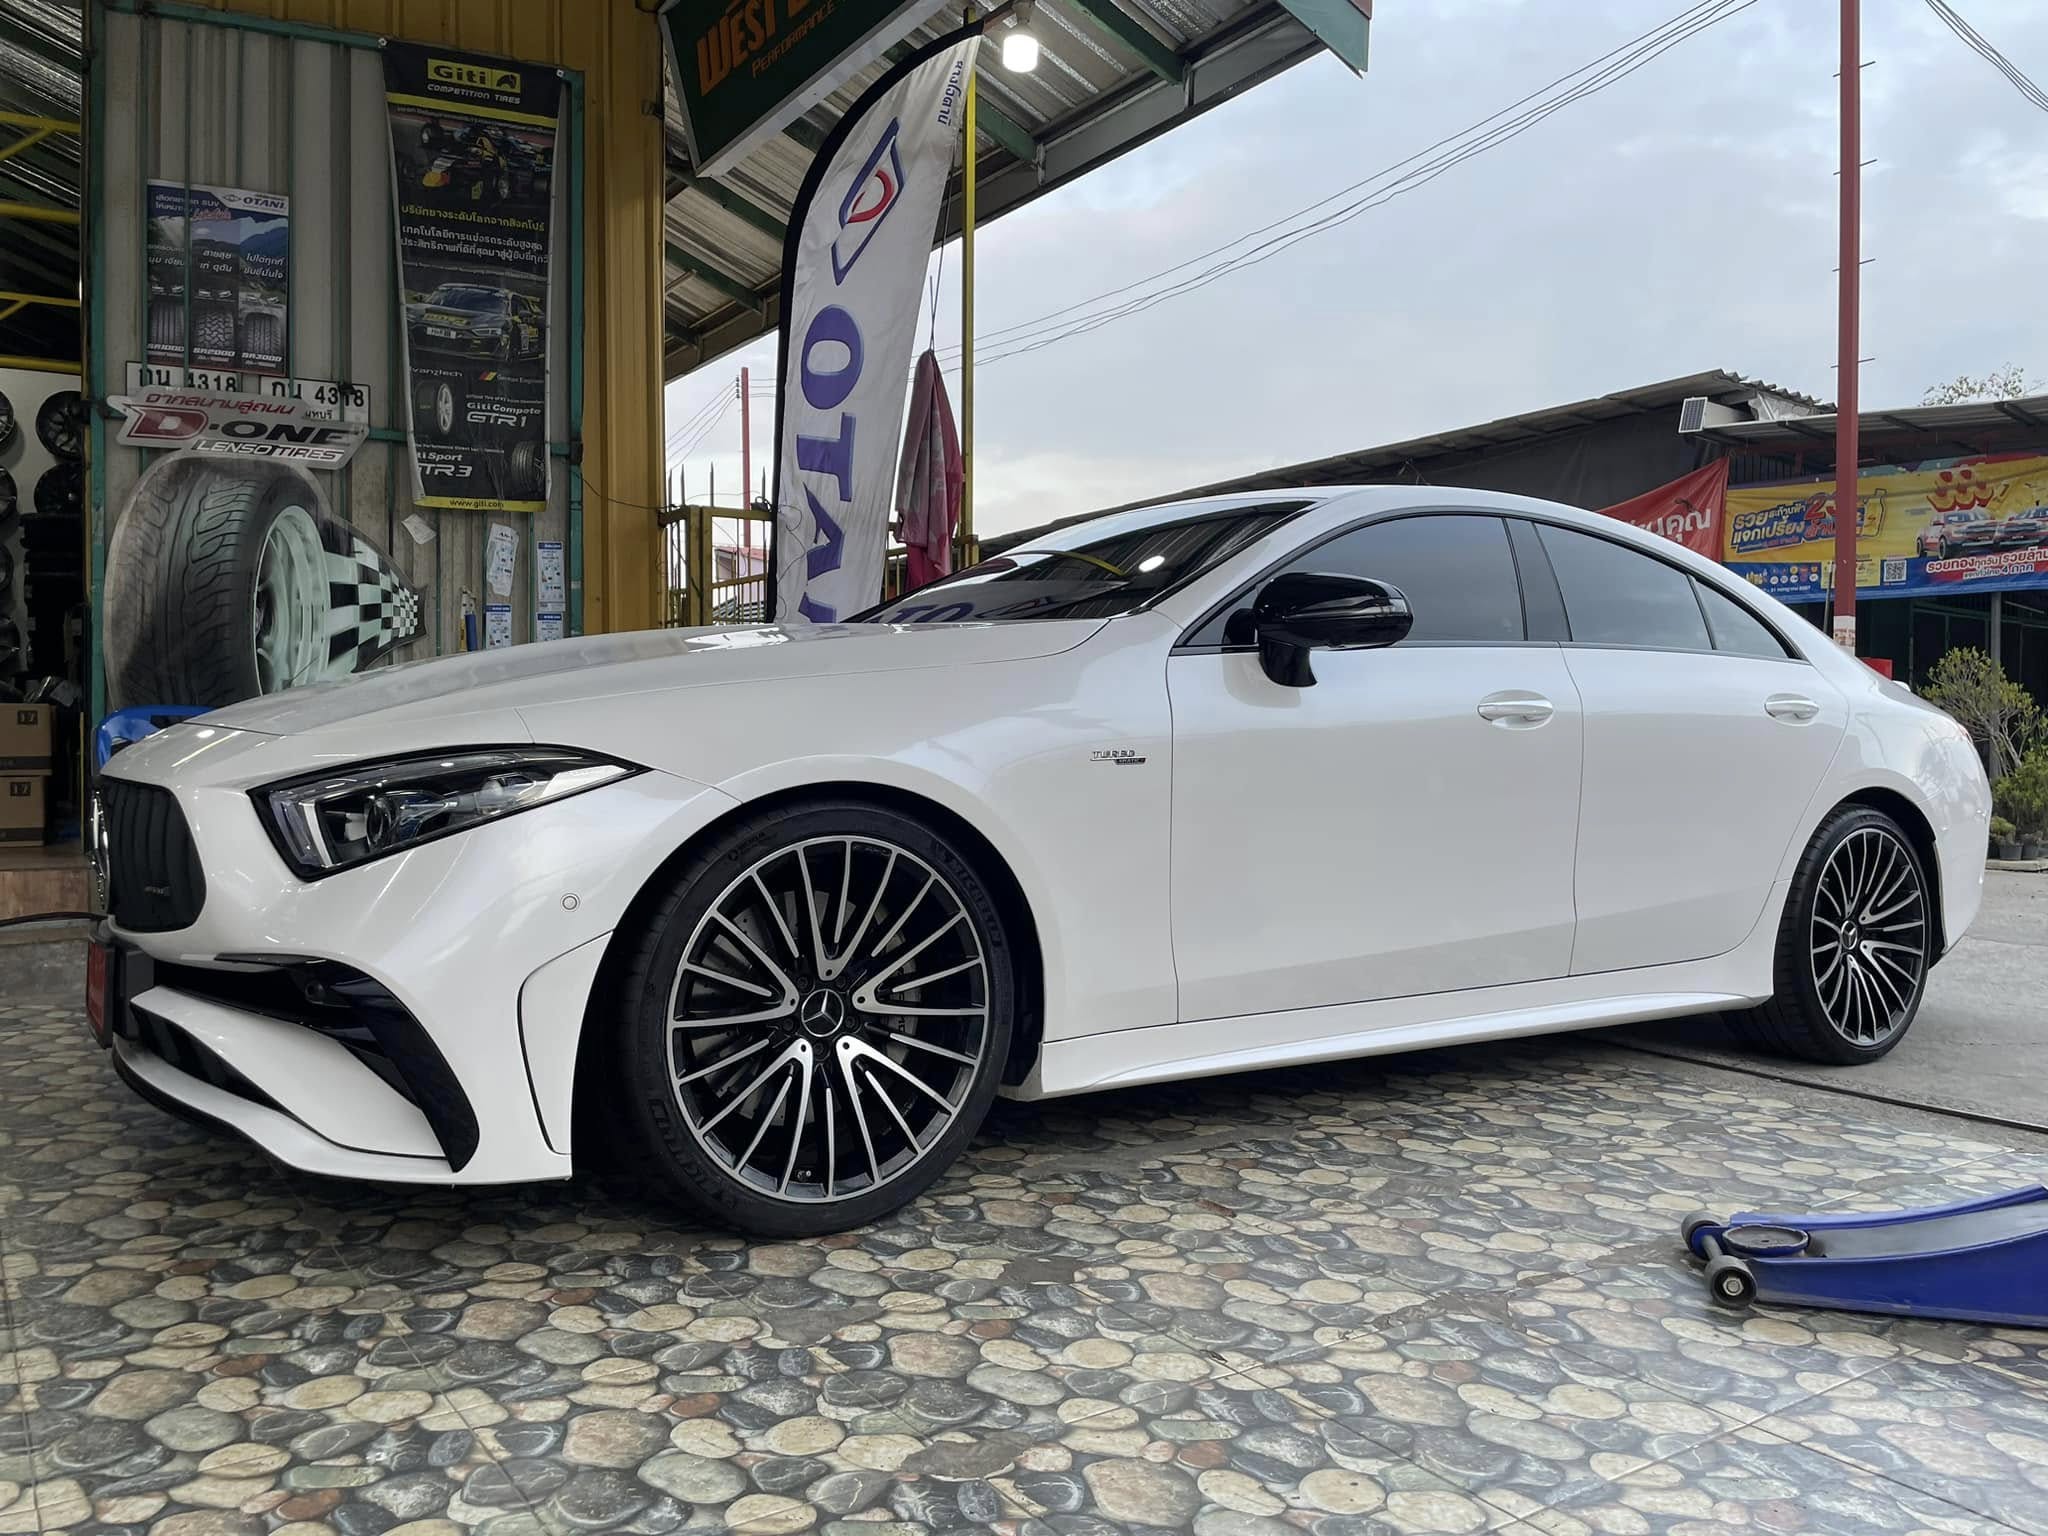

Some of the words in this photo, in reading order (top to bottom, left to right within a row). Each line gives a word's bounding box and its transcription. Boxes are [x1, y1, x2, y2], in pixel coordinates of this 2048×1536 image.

[433, 65, 487, 85] Giti
[427, 83, 490, 100] COMPETITION
[494, 94, 521, 105] TIRES
[243, 196, 285, 209] OTANI
[145, 392, 295, 416] จากสนามสู่ถนน
[196, 439, 273, 456] LENSO
[275, 444, 338, 461] TIRES
[449, 500, 505, 509] www.giti.com
